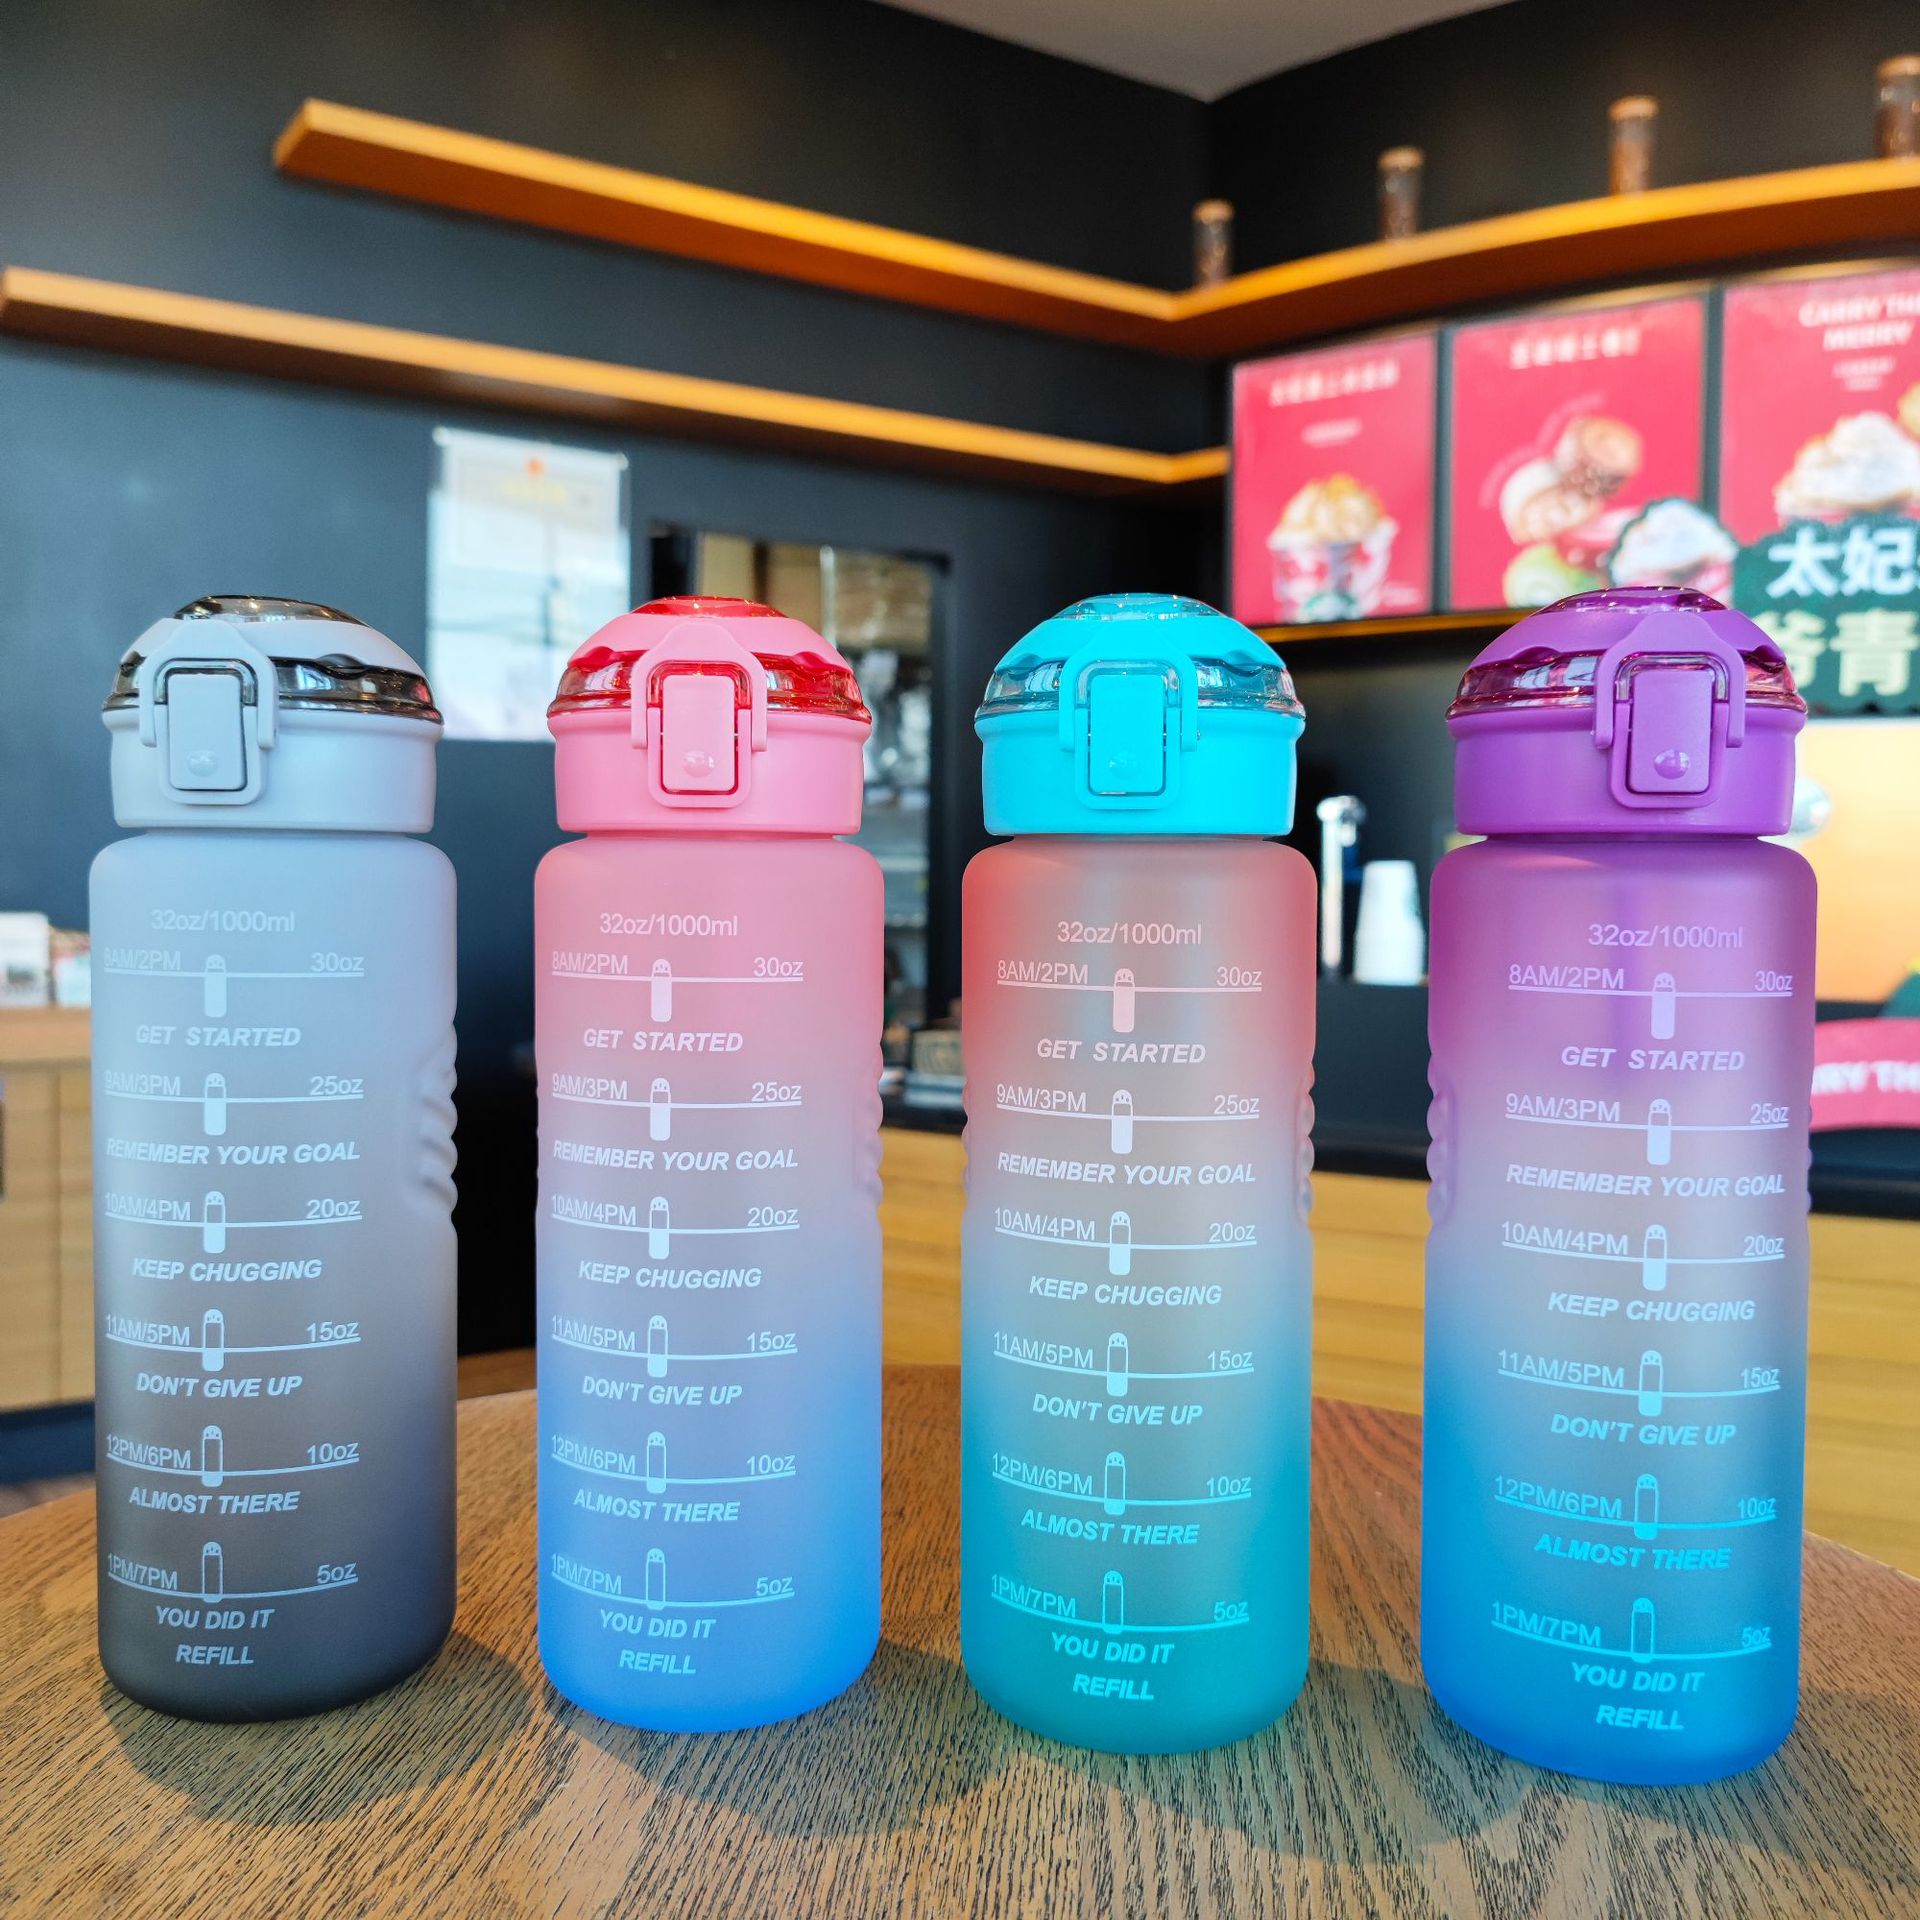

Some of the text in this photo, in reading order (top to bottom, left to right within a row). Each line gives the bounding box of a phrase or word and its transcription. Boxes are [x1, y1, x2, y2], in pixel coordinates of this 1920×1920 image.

[1765, 526, 1920, 598] 太妃
[151, 909, 296, 932] 32oz/1000ml
[599, 912, 738, 937] 32oz/1000ml
[1057, 921, 1202, 945] 32oz/1000ml
[1588, 924, 1743, 949] 32oz/1000ml
[104, 948, 181, 971] 8AM/2PM
[311, 952, 364, 972] 30oz
[552, 951, 629, 974] 8AM/2PM
[753, 957, 804, 977] 30oz
[997, 960, 1088, 983] 8AM/2PM
[1216, 967, 1262, 987] 30oz
[1509, 964, 1624, 990] 8AM/2PM
[1754, 970, 1793, 992] 30oz
[136, 1026, 301, 1047] GET STARTED
[583, 1028, 743, 1052] GET STARTED
[1037, 1039, 1206, 1063] GET STARTED
[1561, 1046, 1744, 1071] GET STARTED
[104, 1071, 181, 1096] 9AM/3PM
[309, 1075, 364, 1096] 25oz
[552, 1072, 628, 1100] 9AM/3PM
[751, 1082, 802, 1102] 25oz
[996, 1085, 1087, 1112] 9AM/3PM
[1214, 1095, 1259, 1115] 25oz
[1505, 1092, 1621, 1122] 9AM/3PM
[1750, 1103, 1789, 1124] 25oz
[106, 1138, 361, 1164] REMEMBER YOUR GOAL
[553, 1140, 798, 1171] REMEMBER YOUR GOAL
[997, 1152, 1256, 1185] REMEMBER YOUR GOAL
[1506, 1164, 1785, 1197] REMEMBER YOUR GOAL
[104, 1192, 191, 1221] 10AM/4PM
[306, 1198, 361, 1219] 20oz
[551, 1194, 637, 1226] 10AM/4PM
[748, 1207, 799, 1228] 20oz
[994, 1208, 1096, 1241] 10AM/4PM
[1209, 1222, 1256, 1242] 20oz
[1501, 1221, 1629, 1256] 10AM/4PM
[1744, 1235, 1784, 1257] 20oz
[132, 1258, 323, 1282] KEEP CHUGGING
[578, 1260, 762, 1289] KEEP CHUGGING
[1029, 1276, 1223, 1305] KEEP CHUGGING
[1548, 1291, 1756, 1322] KEEP CHUGGING
[105, 1313, 191, 1346] 11AM/5PM
[306, 1321, 359, 1342] 15oz
[552, 1315, 636, 1351] 11AM/5PM
[746, 1331, 796, 1352] 15oz
[993, 1331, 1094, 1369] 11AM/5PM
[1207, 1351, 1253, 1371] 15oz
[1499, 1349, 1624, 1388] 11AM/5PM
[1740, 1368, 1779, 1389] 15oz
[203, 1378, 261, 1398] GIVE
[268, 1376, 303, 1396] UP
[648, 1384, 703, 1406] GIVE
[709, 1385, 742, 1406] UP
[1108, 1404, 1165, 1425] GIVE
[1171, 1404, 1203, 1425] UP
[1638, 1424, 1699, 1446] GIVE
[1705, 1424, 1736, 1445] UP
[106, 1434, 192, 1469] 12PM/6PM
[306, 1441, 359, 1464] 10oz
[551, 1434, 636, 1474] 12PM/6PM
[746, 1454, 796, 1476] 10oz
[992, 1453, 1093, 1496] 12PM/6PM
[1206, 1476, 1252, 1497] 10oz
[1494, 1476, 1622, 1519] 12PM/6PM
[129, 1487, 301, 1514] ALMOST THERE
[574, 1488, 741, 1522] ALMOST THERE
[1737, 1497, 1776, 1519] 10oz
[1021, 1509, 1200, 1545] ALMOST THERE
[1534, 1534, 1731, 1571] ALMOST THERE
[108, 1552, 178, 1590] 1PM/7PM
[317, 1561, 358, 1584] 5oz
[552, 1554, 622, 1595] 1PM/7PM
[756, 1576, 794, 1597] 5oz
[991, 1574, 1077, 1618] 1PM/7PM
[156, 1606, 275, 1629] YOU DID IT
[600, 1609, 716, 1638] YOU DID IT
[1213, 1601, 1248, 1622] 5oz
[1492, 1601, 1601, 1647] 1PM/7PM
[1052, 1632, 1174, 1664] YOU DID IT
[1741, 1626, 1770, 1648] 5oz
[176, 1644, 254, 1664] REFILL
[619, 1650, 697, 1674] REFILL
[1072, 1674, 1155, 1701] REFILL
[1571, 1662, 1704, 1692] YOU DID IT
[1596, 1705, 1684, 1731] REFILL
